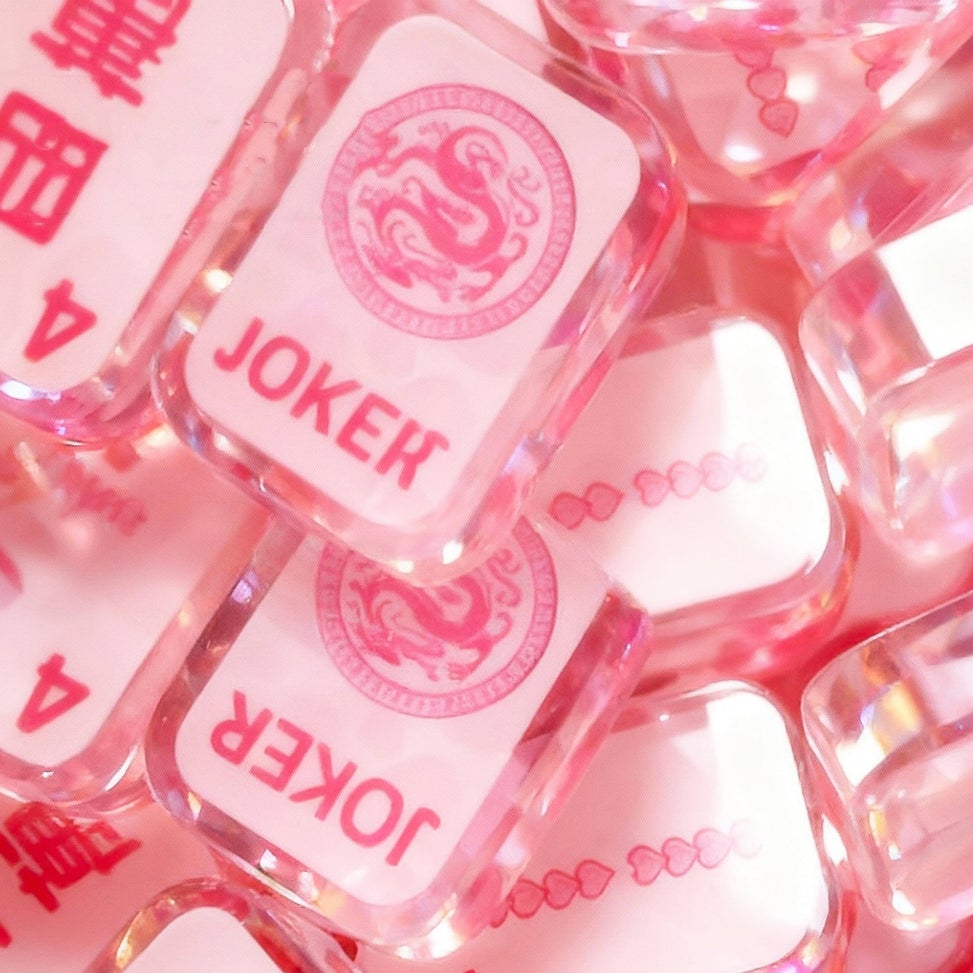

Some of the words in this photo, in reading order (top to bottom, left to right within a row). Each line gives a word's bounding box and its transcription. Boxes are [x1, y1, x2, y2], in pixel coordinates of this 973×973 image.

[25, 278, 97, 363] 4
[214, 317, 450, 491] JOKER
[16, 653, 90, 734] 4
[210, 689, 441, 867] JOKER
